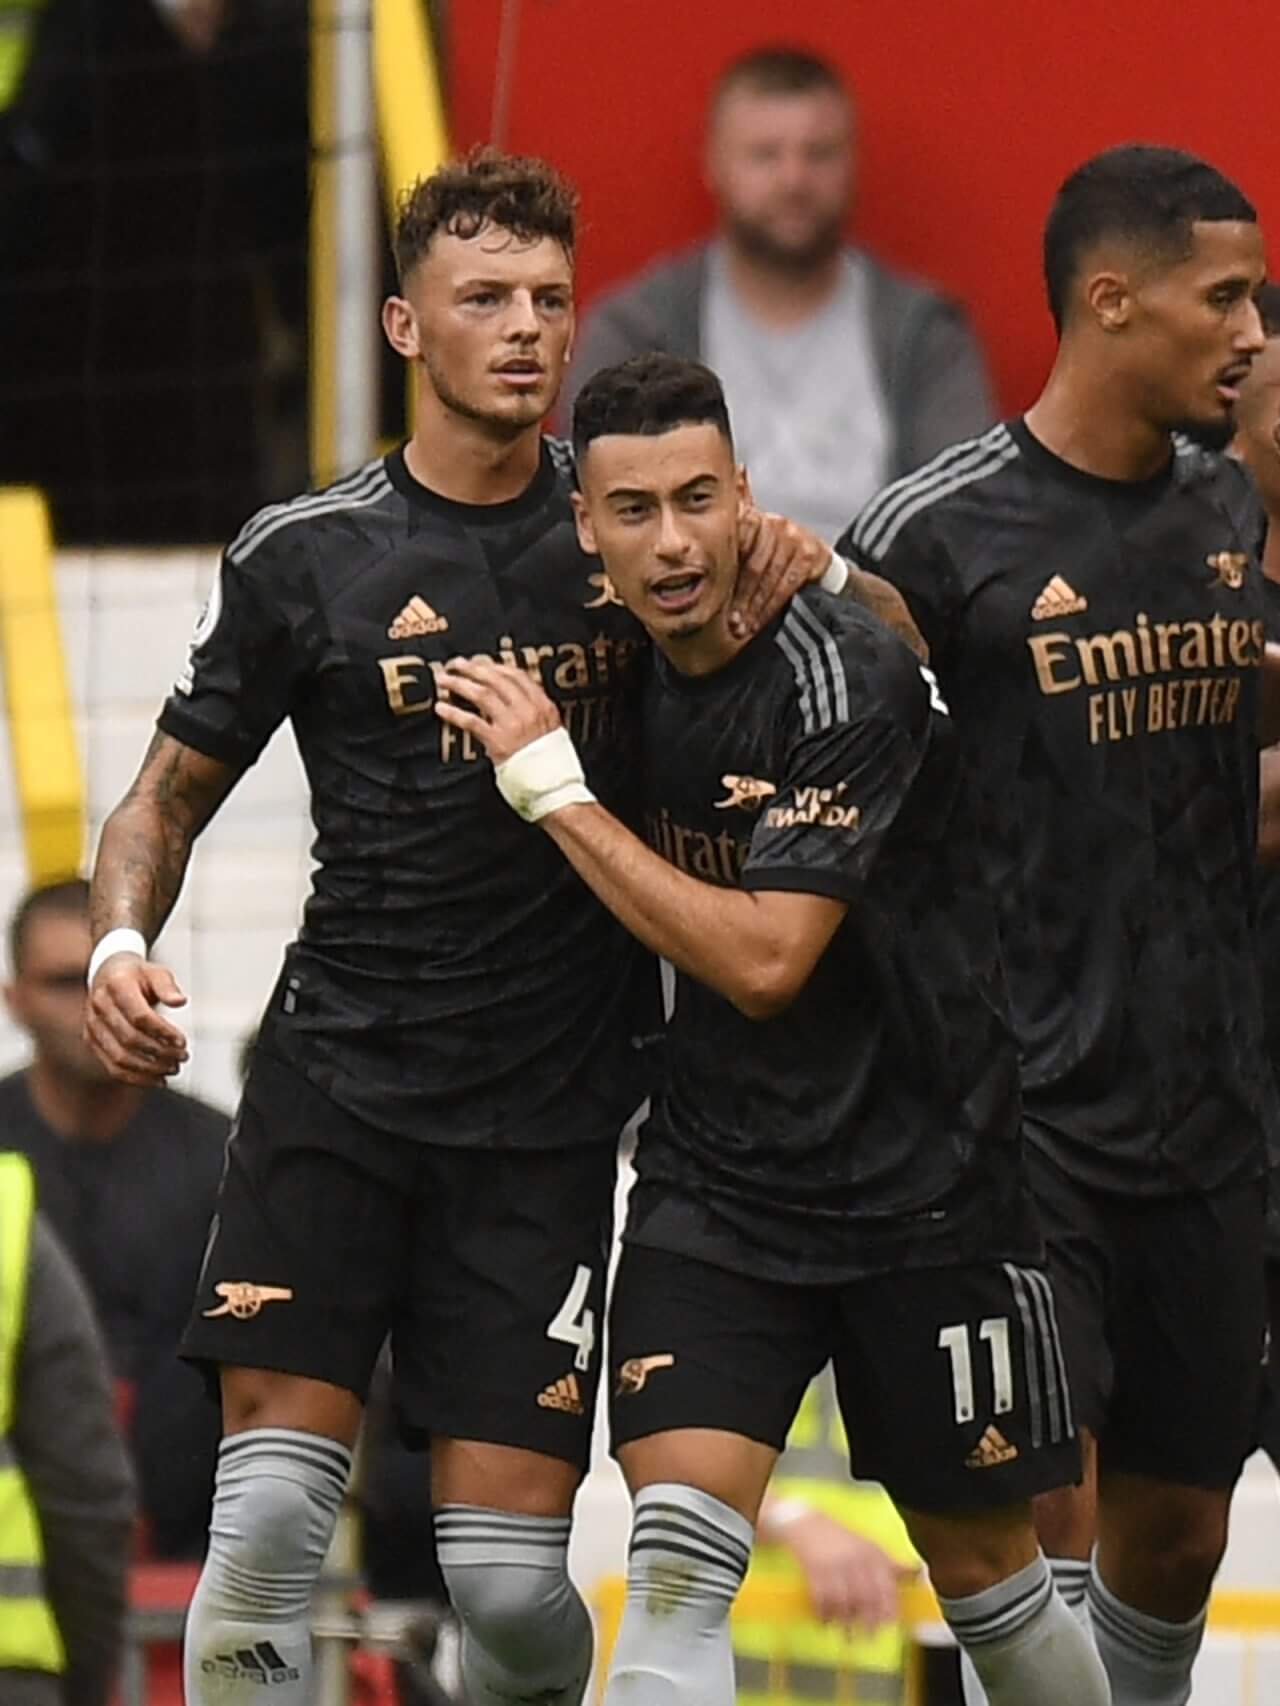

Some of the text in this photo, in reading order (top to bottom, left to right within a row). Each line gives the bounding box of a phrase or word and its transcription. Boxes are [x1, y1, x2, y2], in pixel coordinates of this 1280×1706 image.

[1027, 612, 1264, 694] Emirates
[1090, 677, 1241, 745] FLY BETTER
[547, 1264, 594, 1371] 4
[938, 1317, 1012, 1424] 11
